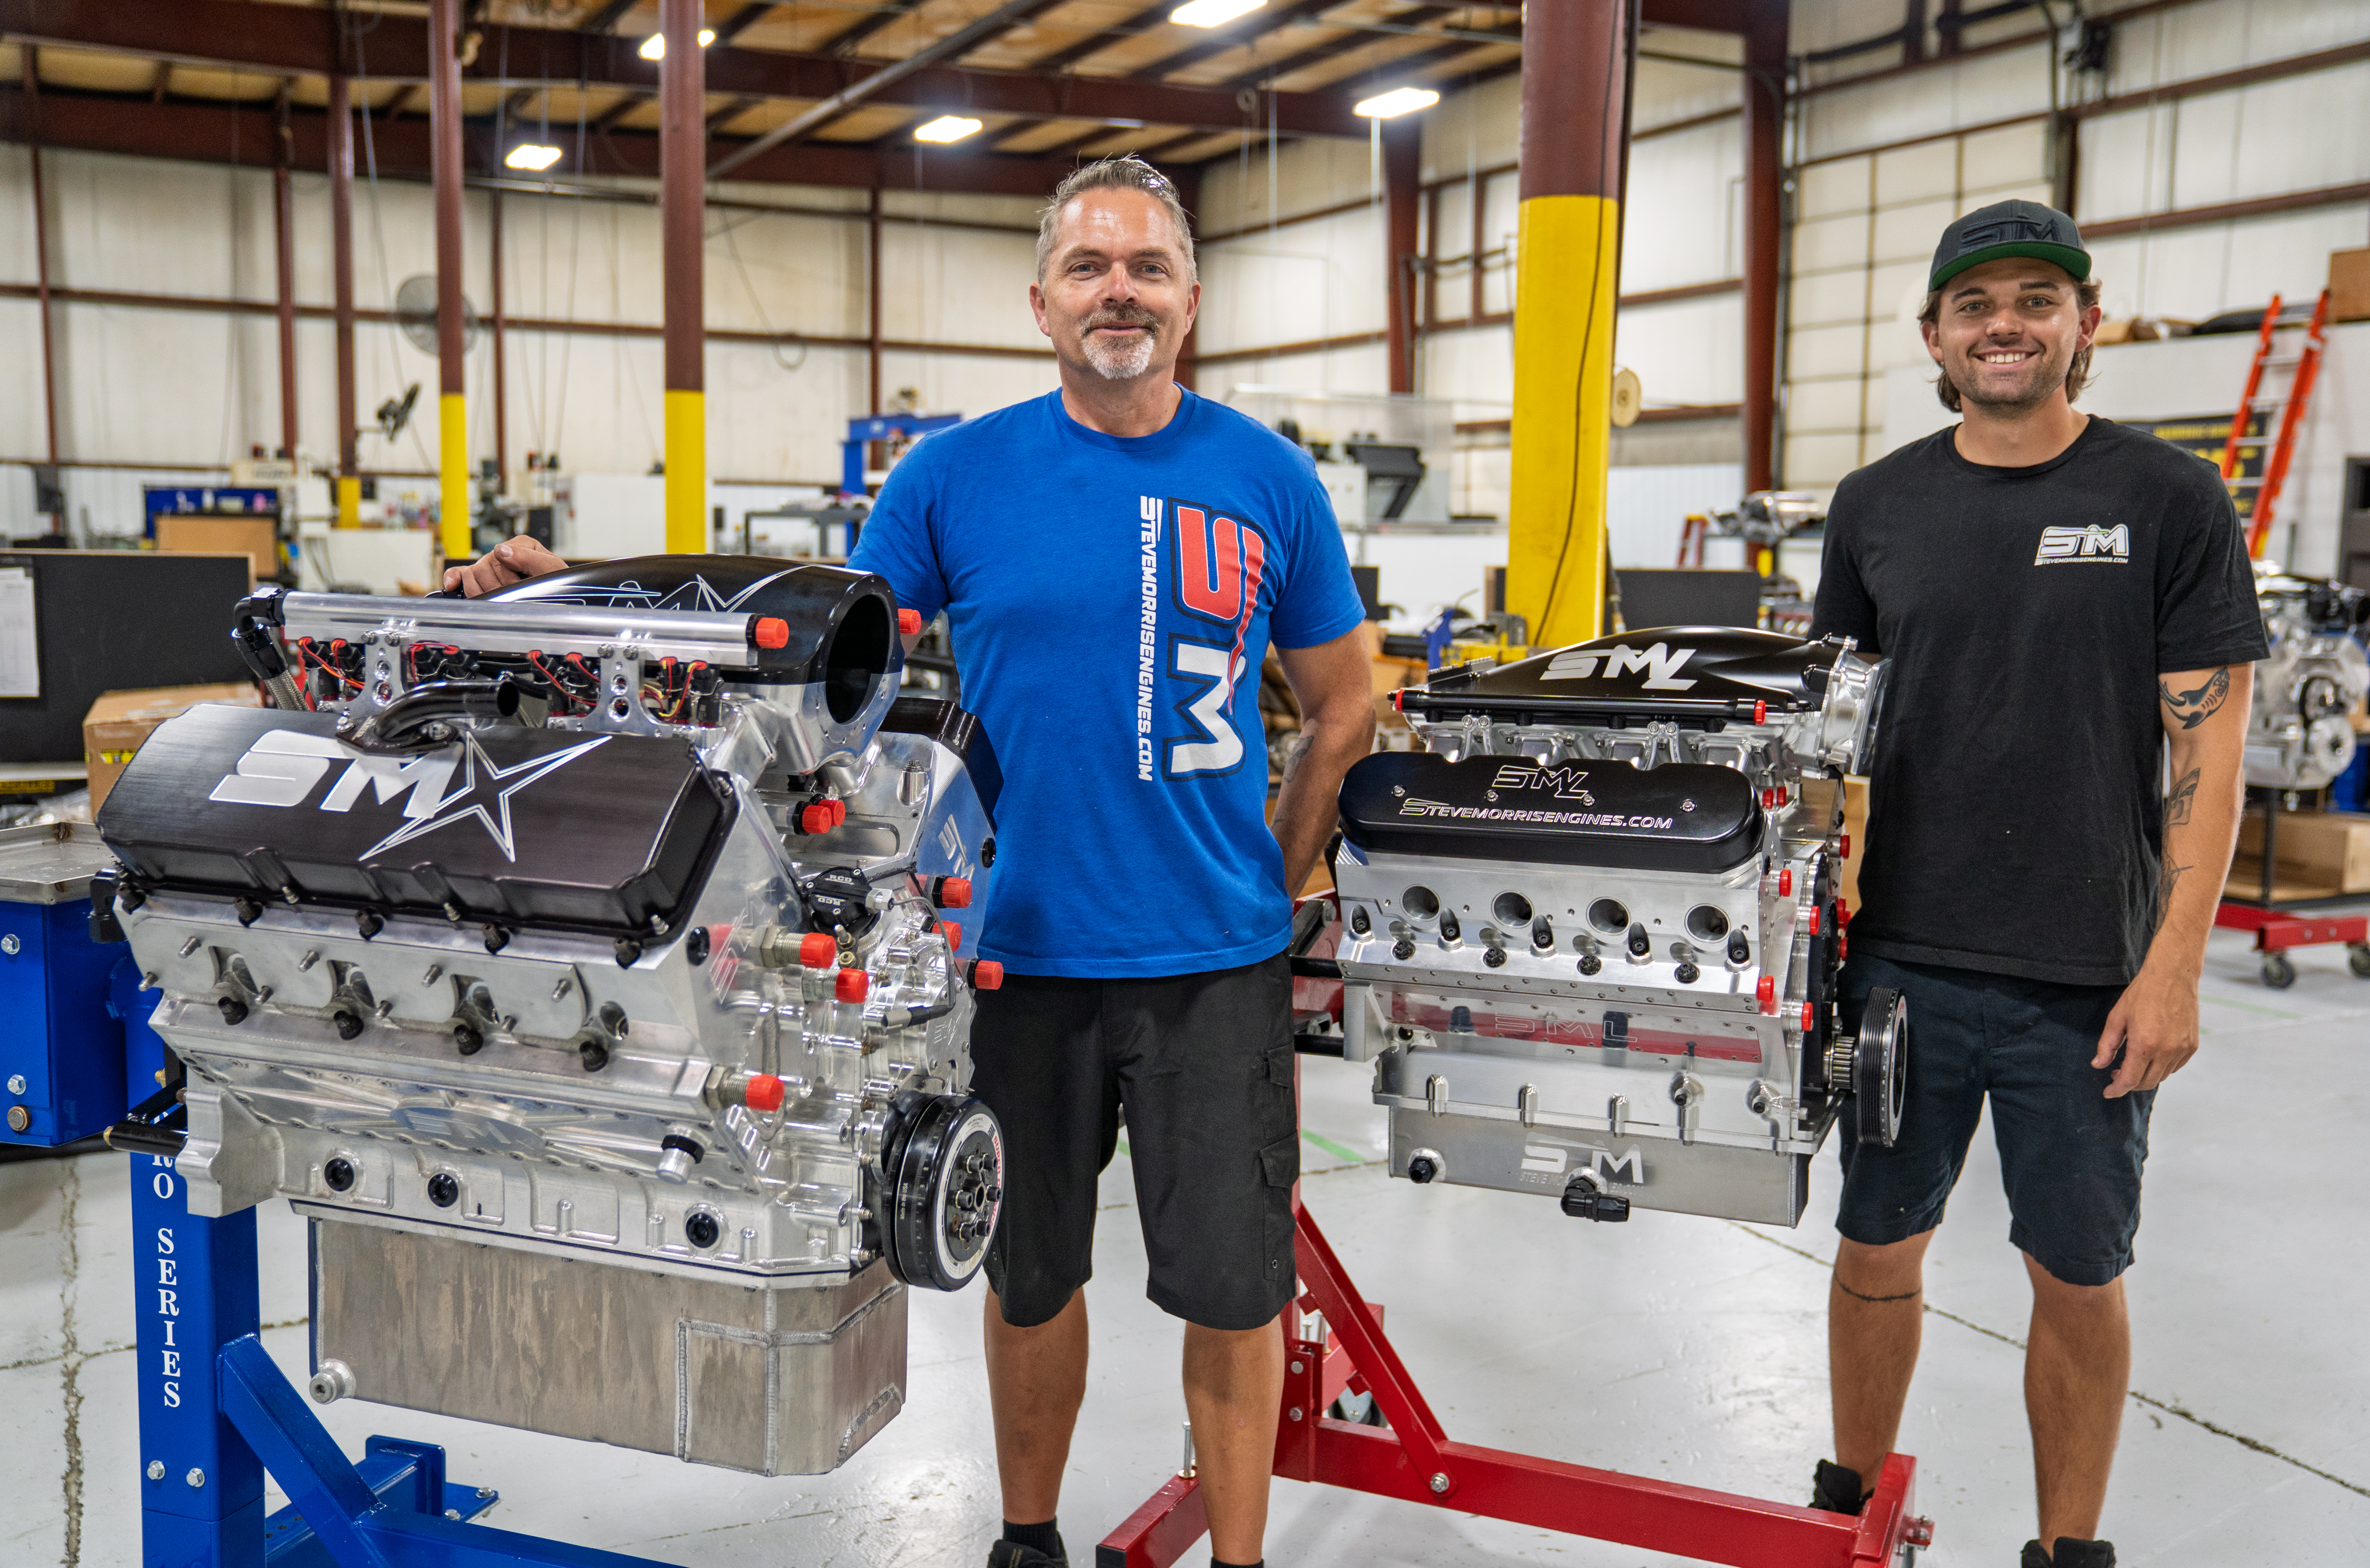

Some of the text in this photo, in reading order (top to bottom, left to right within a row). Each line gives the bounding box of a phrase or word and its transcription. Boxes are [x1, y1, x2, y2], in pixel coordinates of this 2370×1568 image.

[2036, 523, 2129, 558] SM
[2034, 556, 2129, 566] STEVEMORRISENGINES.COM
[1138, 496, 1163, 781] STEVEMORRISENGINES.COM
[1164, 497, 1269, 781] SM
[1399, 798, 1672, 828] STEVEMORRISENGINES.COM
[829, 874, 852, 883] RCD
[818, 897, 841, 906] RCD
[1521, 1131, 1644, 1184] SM
[158, 1227, 180, 1408] SERIES
